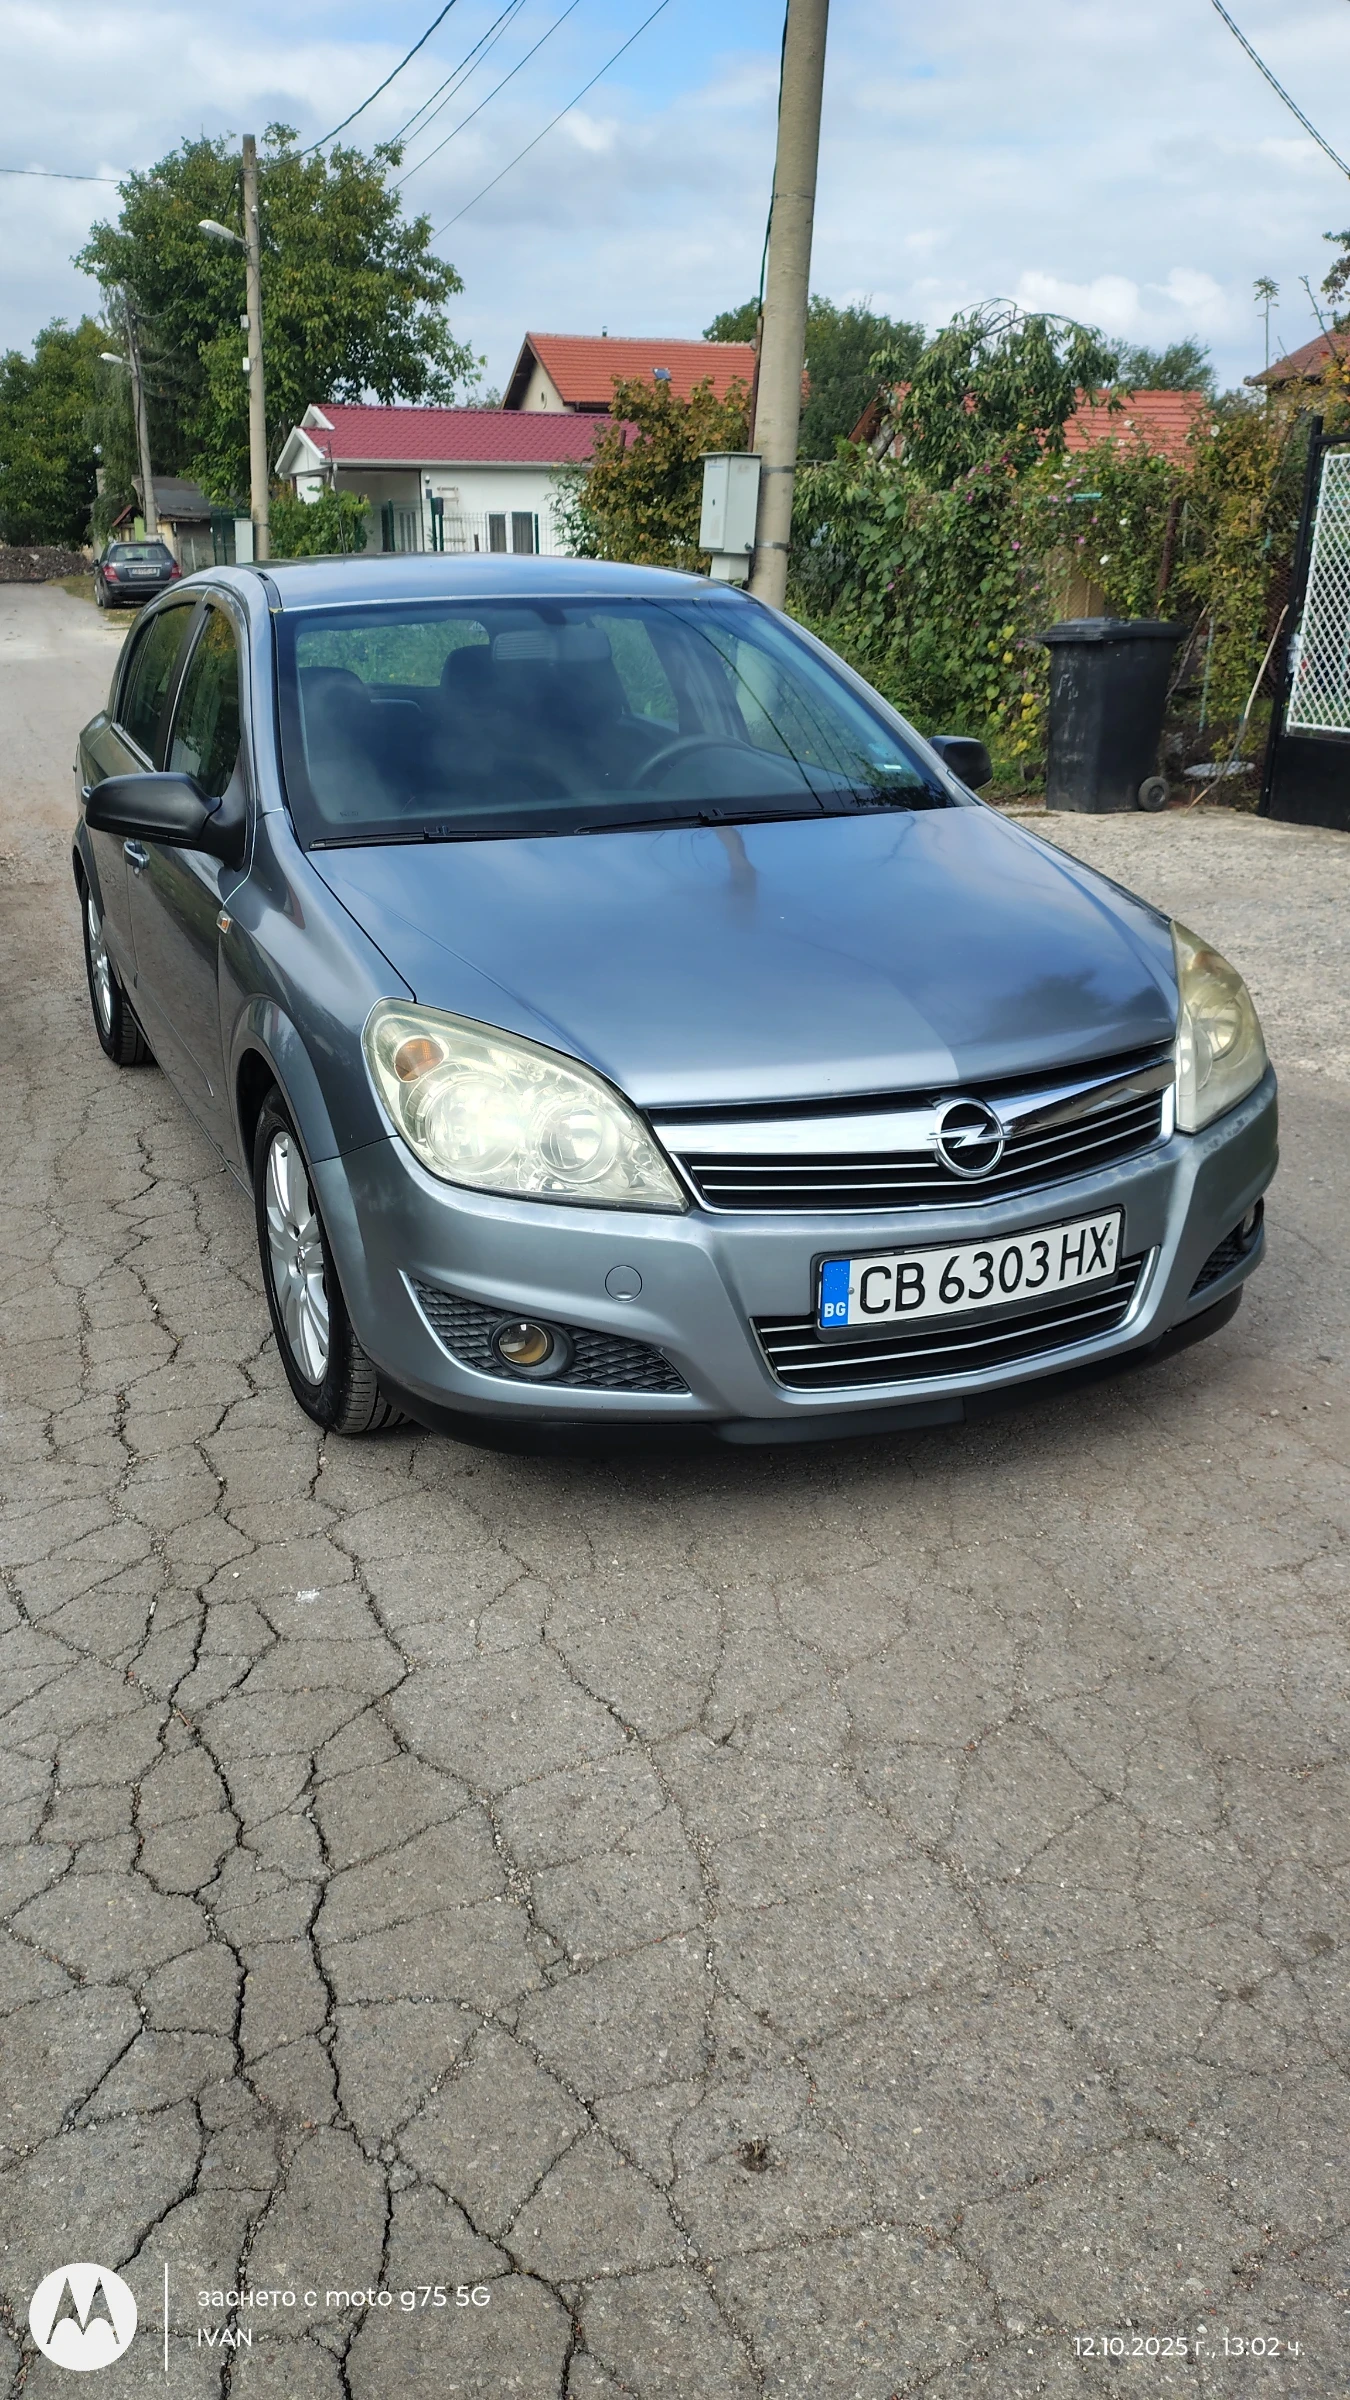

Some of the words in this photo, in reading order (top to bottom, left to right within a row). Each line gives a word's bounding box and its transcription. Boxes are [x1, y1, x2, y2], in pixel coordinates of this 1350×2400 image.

[859, 1262, 926, 1315] CB
[938, 1240, 1050, 1305] 6303
[1058, 1221, 1112, 1282] HX
[824, 1301, 846, 1318] BG
